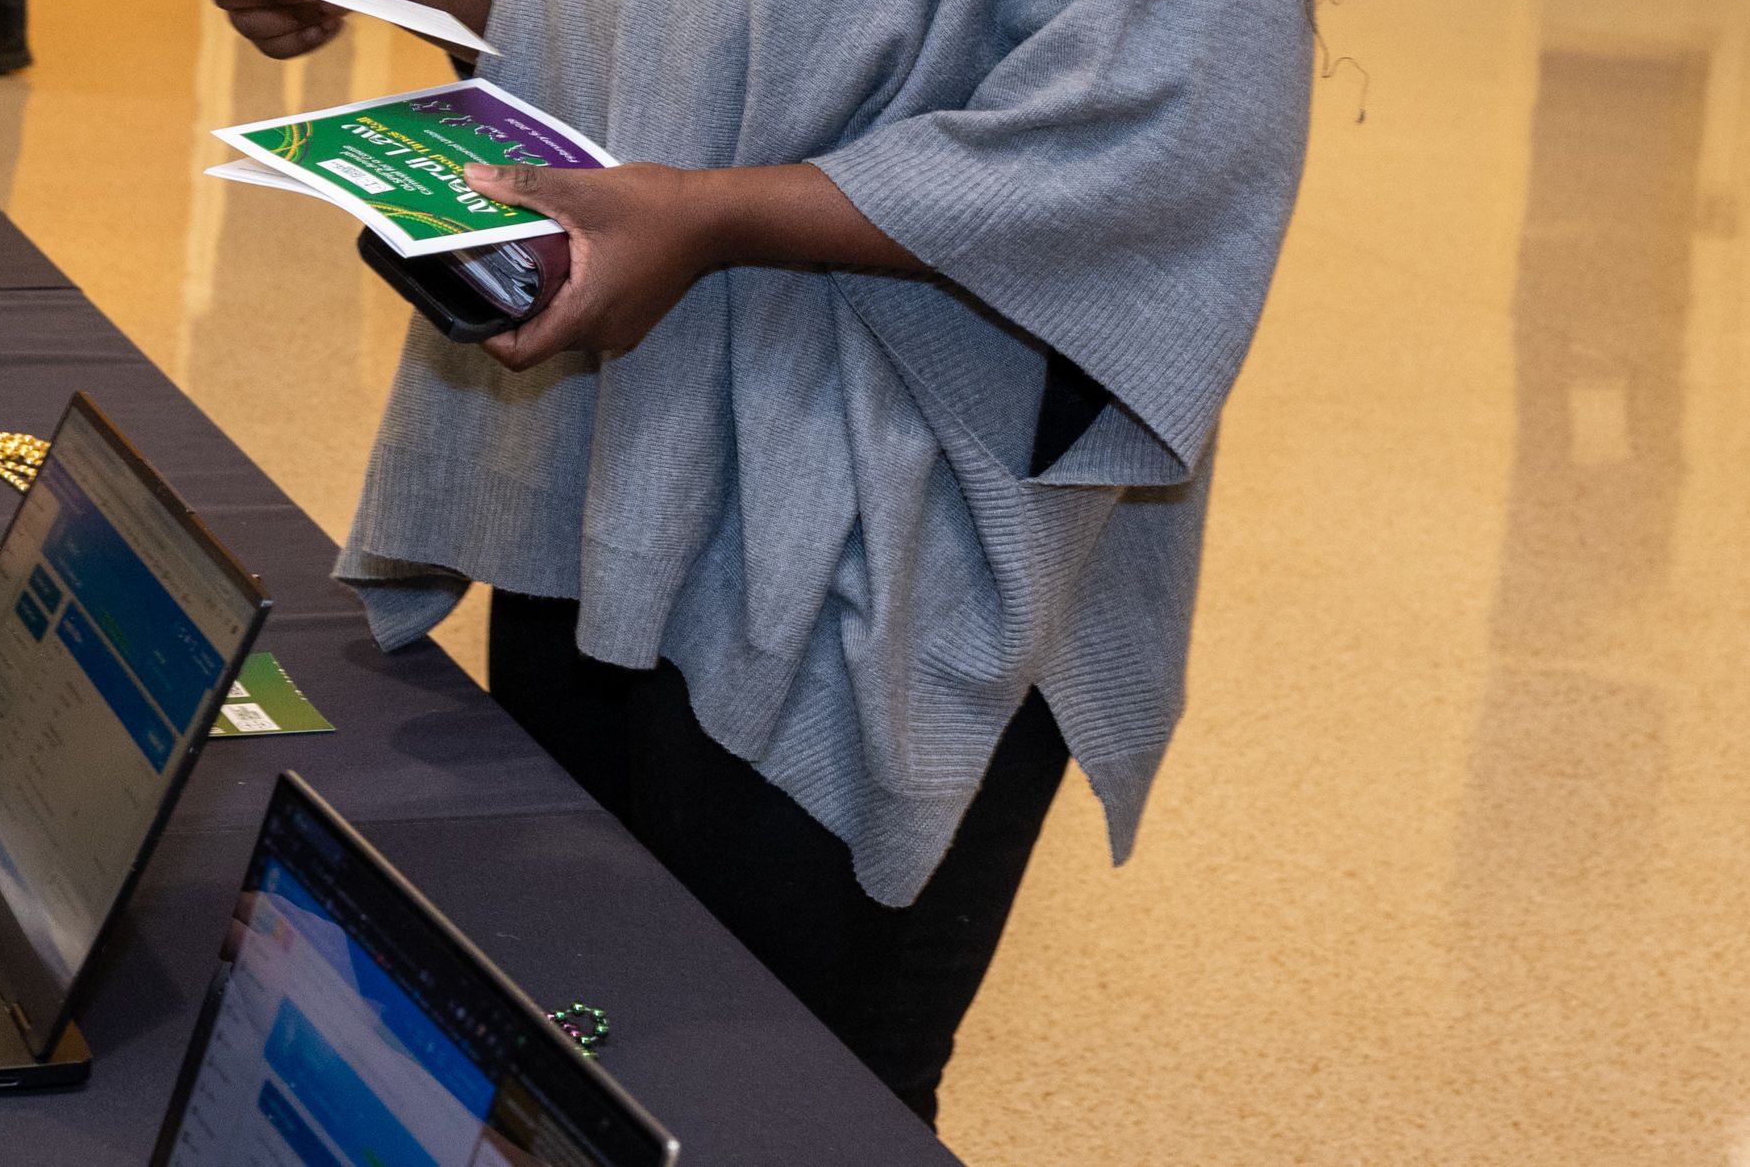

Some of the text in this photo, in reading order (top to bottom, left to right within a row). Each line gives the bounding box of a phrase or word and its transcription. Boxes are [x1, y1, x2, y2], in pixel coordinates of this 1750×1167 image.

[356, 116, 389, 132] Roll
[341, 124, 413, 155] Law
[388, 130, 432, 154] Times
[537, 135, 580, 163] February
[405, 157, 499, 213] Mardi
